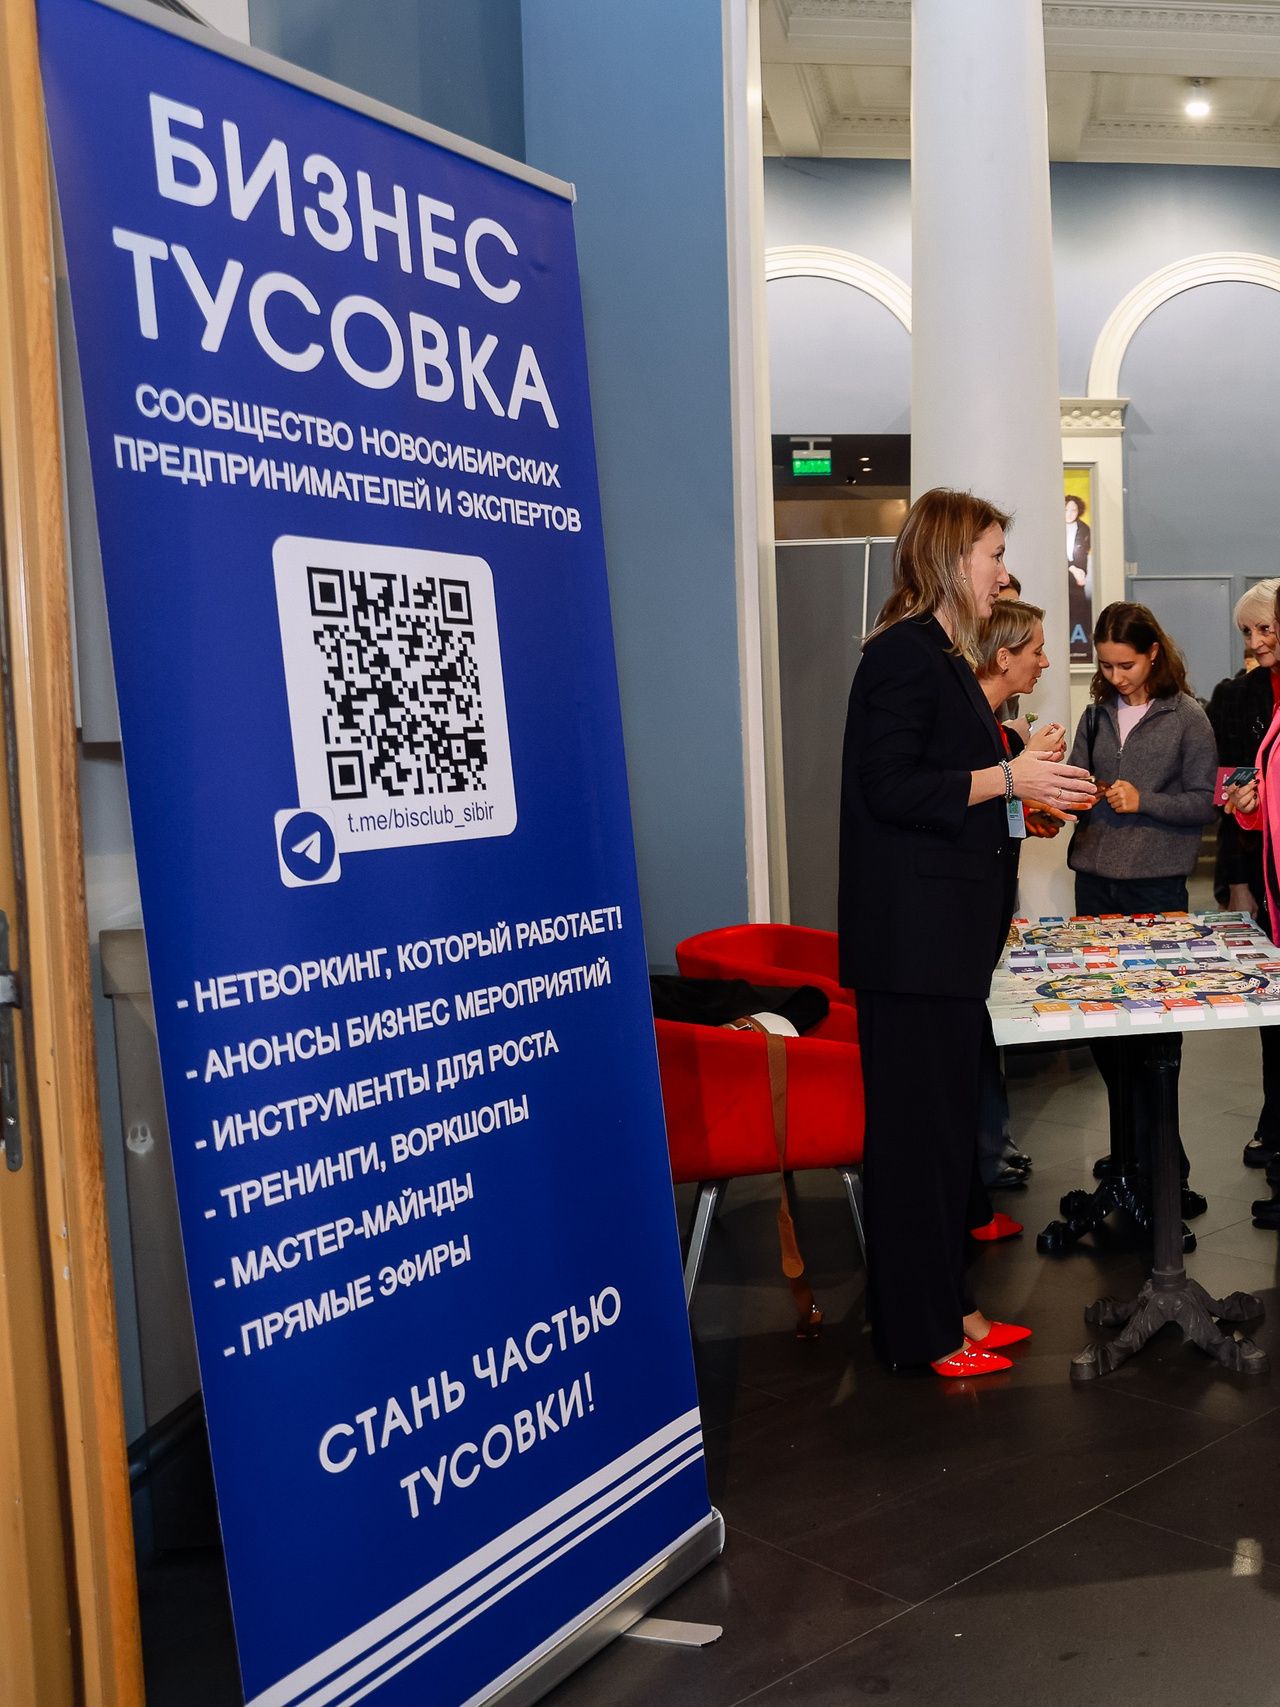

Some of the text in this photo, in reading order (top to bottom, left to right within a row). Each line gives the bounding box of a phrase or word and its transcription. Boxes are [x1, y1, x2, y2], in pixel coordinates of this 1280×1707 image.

[148, 92, 522, 304] БИЗНЕС
[112, 226, 560, 429] ТУСОВКА
[113, 434, 582, 533] ПРЕДПРИНИМАТЕЛЕЙ И ЭКСПЕРТОВ
[135, 383, 562, 489] СООБЩЕСТВО НОВОСИБИРСКИХ
[346, 801, 495, 834] t.me/bisclub_sibir
[194, 947, 392, 1013] НЕТВОРКИНГ,
[396, 920, 512, 973] КОТОРЫЙ
[515, 905, 623, 949] РАБОТАЕТ!
[204, 1022, 341, 1084] АНОНСЫ
[346, 997, 451, 1048] БИЗНЕС
[454, 956, 612, 1022] МЕРОПРИЯТИЙ
[212, 1063, 431, 1152] ИНСТРУМЕНТЫ
[435, 1048, 485, 1094] ДЛЯ
[488, 1029, 560, 1072] РОСТА
[219, 1141, 387, 1219] ТРЕНИНГИ,
[390, 1094, 530, 1164] ВОРКШОПЫ
[231, 1172, 474, 1289] МАСТЕР-МАЙНДЫ
[240, 1274, 375, 1356] ПРЯМЫЕ
[378, 1234, 472, 1296] ЭФИРЫ
[318, 1286, 621, 1474] СТАНЬ ЧАСТЬЮ
[399, 1371, 595, 1519] ТУСОВКИ!
